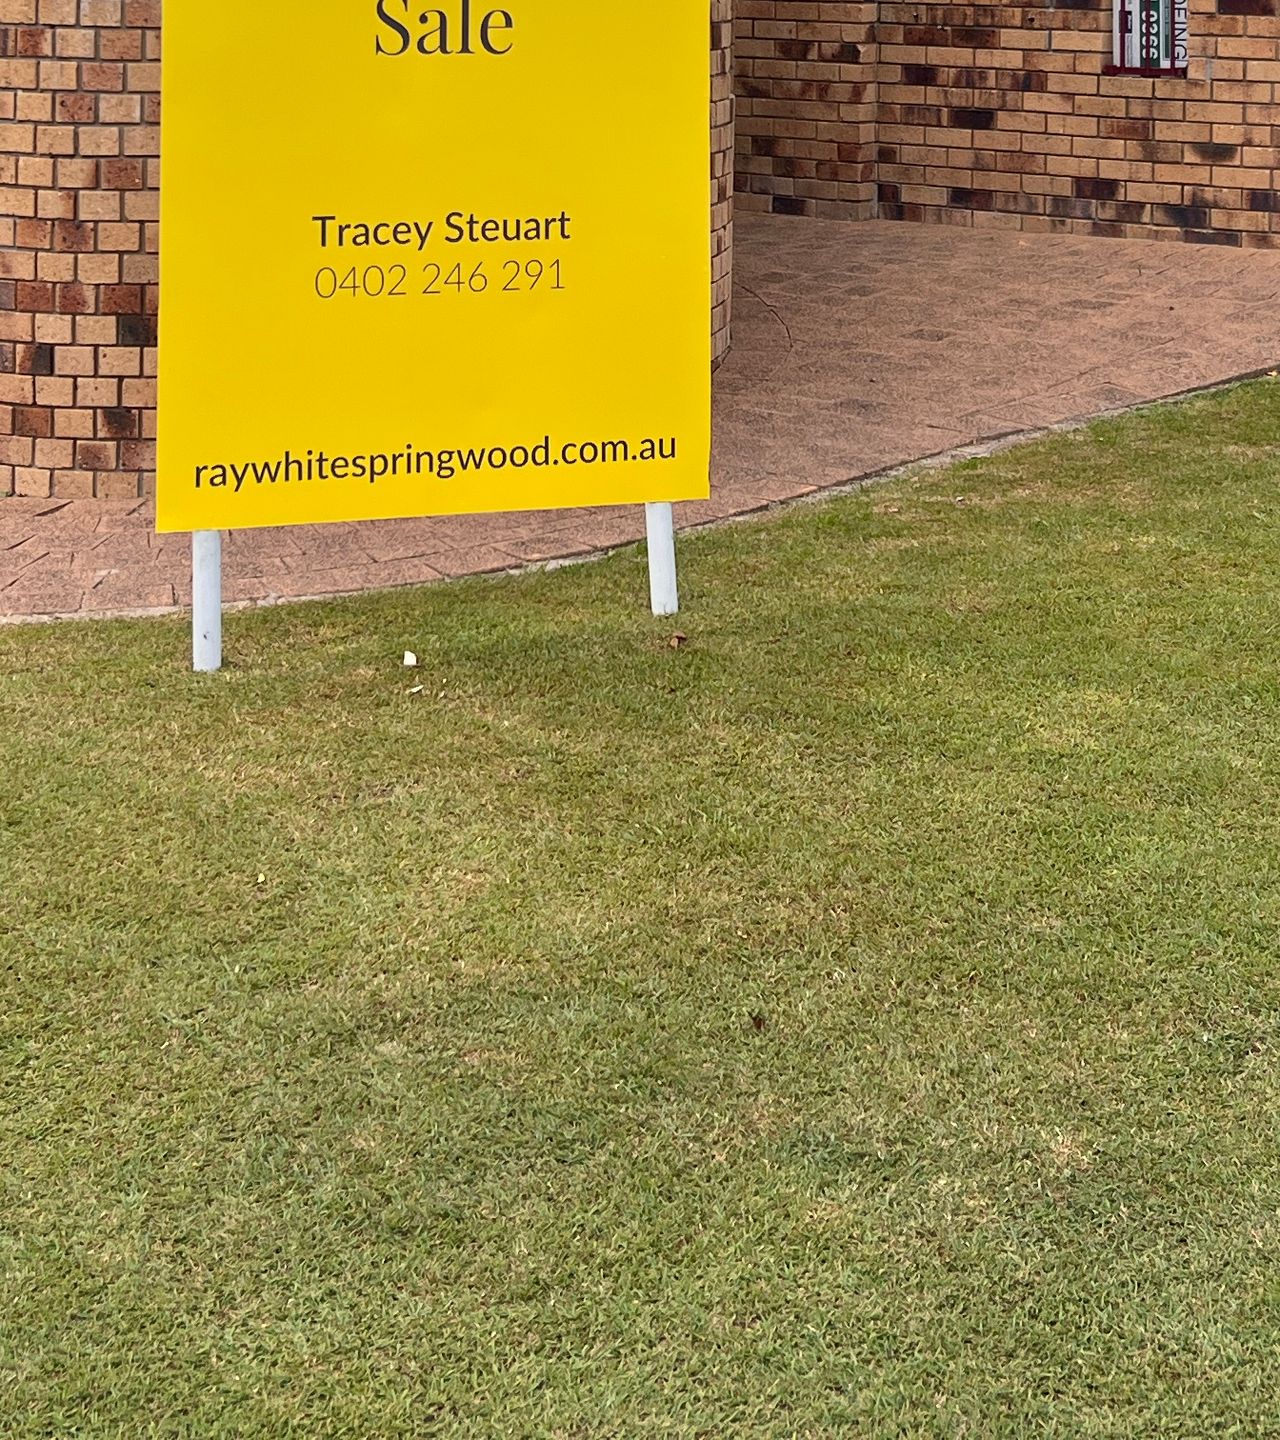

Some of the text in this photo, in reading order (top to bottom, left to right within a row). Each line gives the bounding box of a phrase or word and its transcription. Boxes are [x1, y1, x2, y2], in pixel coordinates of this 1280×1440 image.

[311, 211, 571, 251] Tracey Steuart
[314, 258, 566, 299] 0402 246 291
[195, 435, 676, 492] raywhitespringwood.com.au
